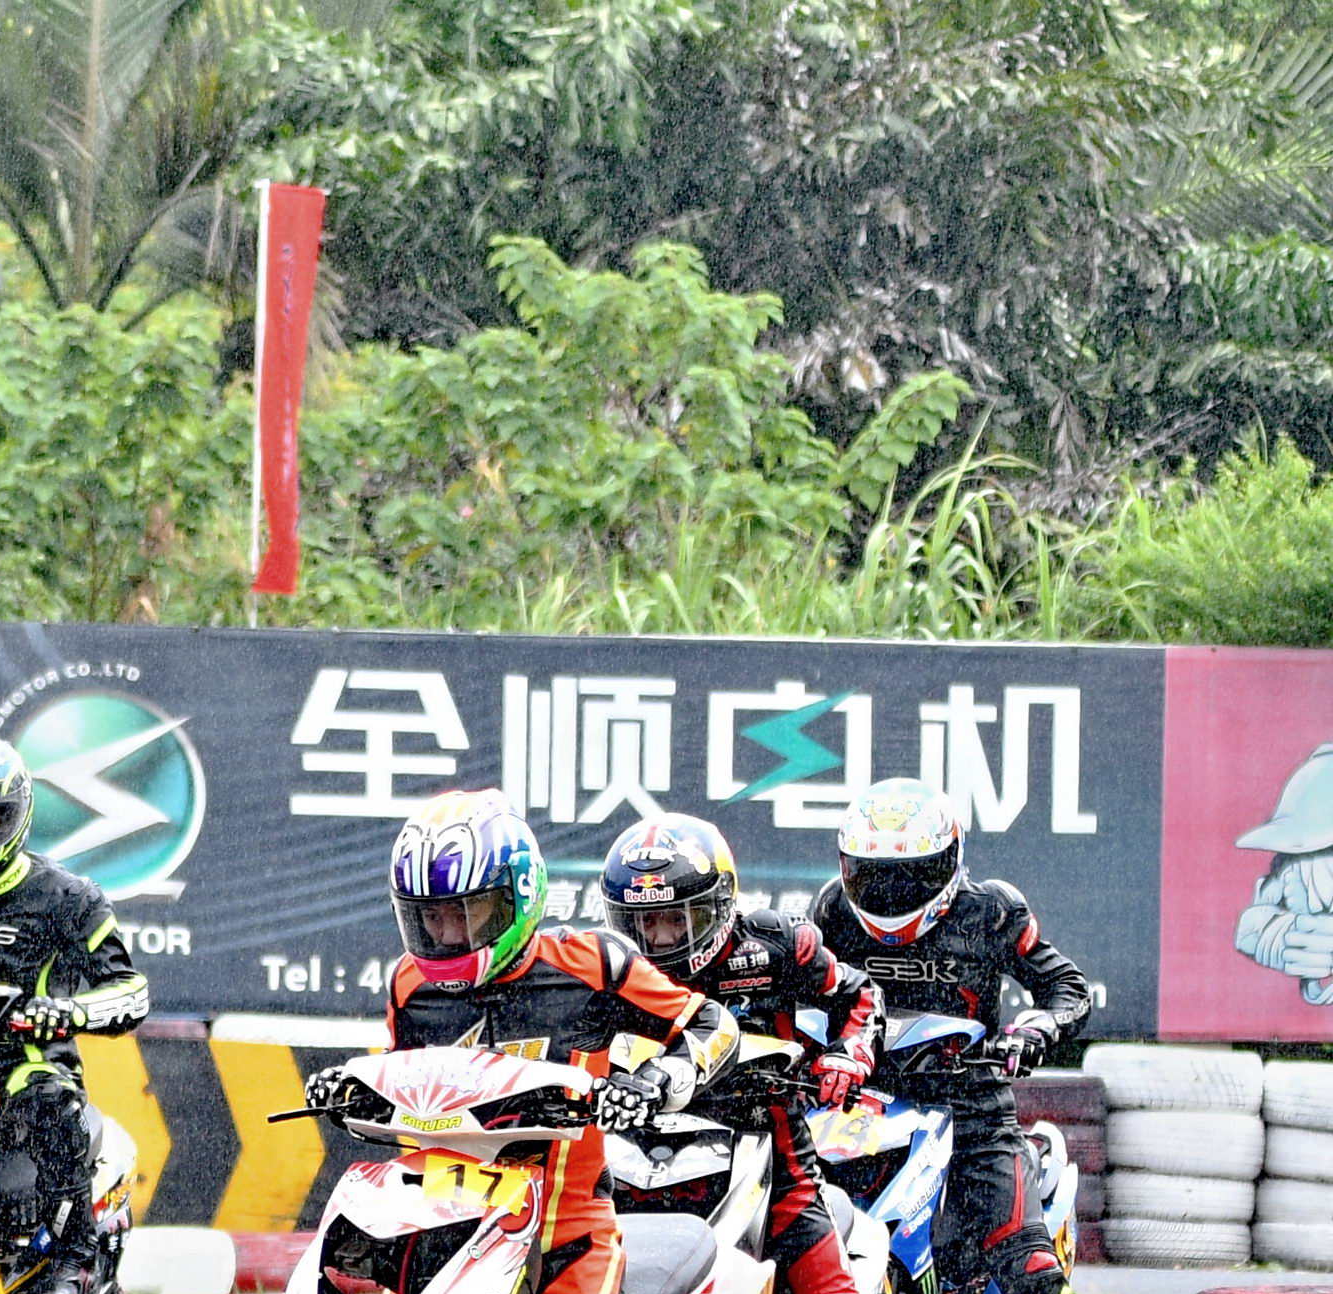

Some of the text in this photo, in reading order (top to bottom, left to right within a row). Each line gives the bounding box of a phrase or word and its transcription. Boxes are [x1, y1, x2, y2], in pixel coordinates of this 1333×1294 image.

[290, 668, 1097, 834] 全顺电机
[625, 887, 674, 902] Red Bull
[446, 1163, 503, 1202] 17
